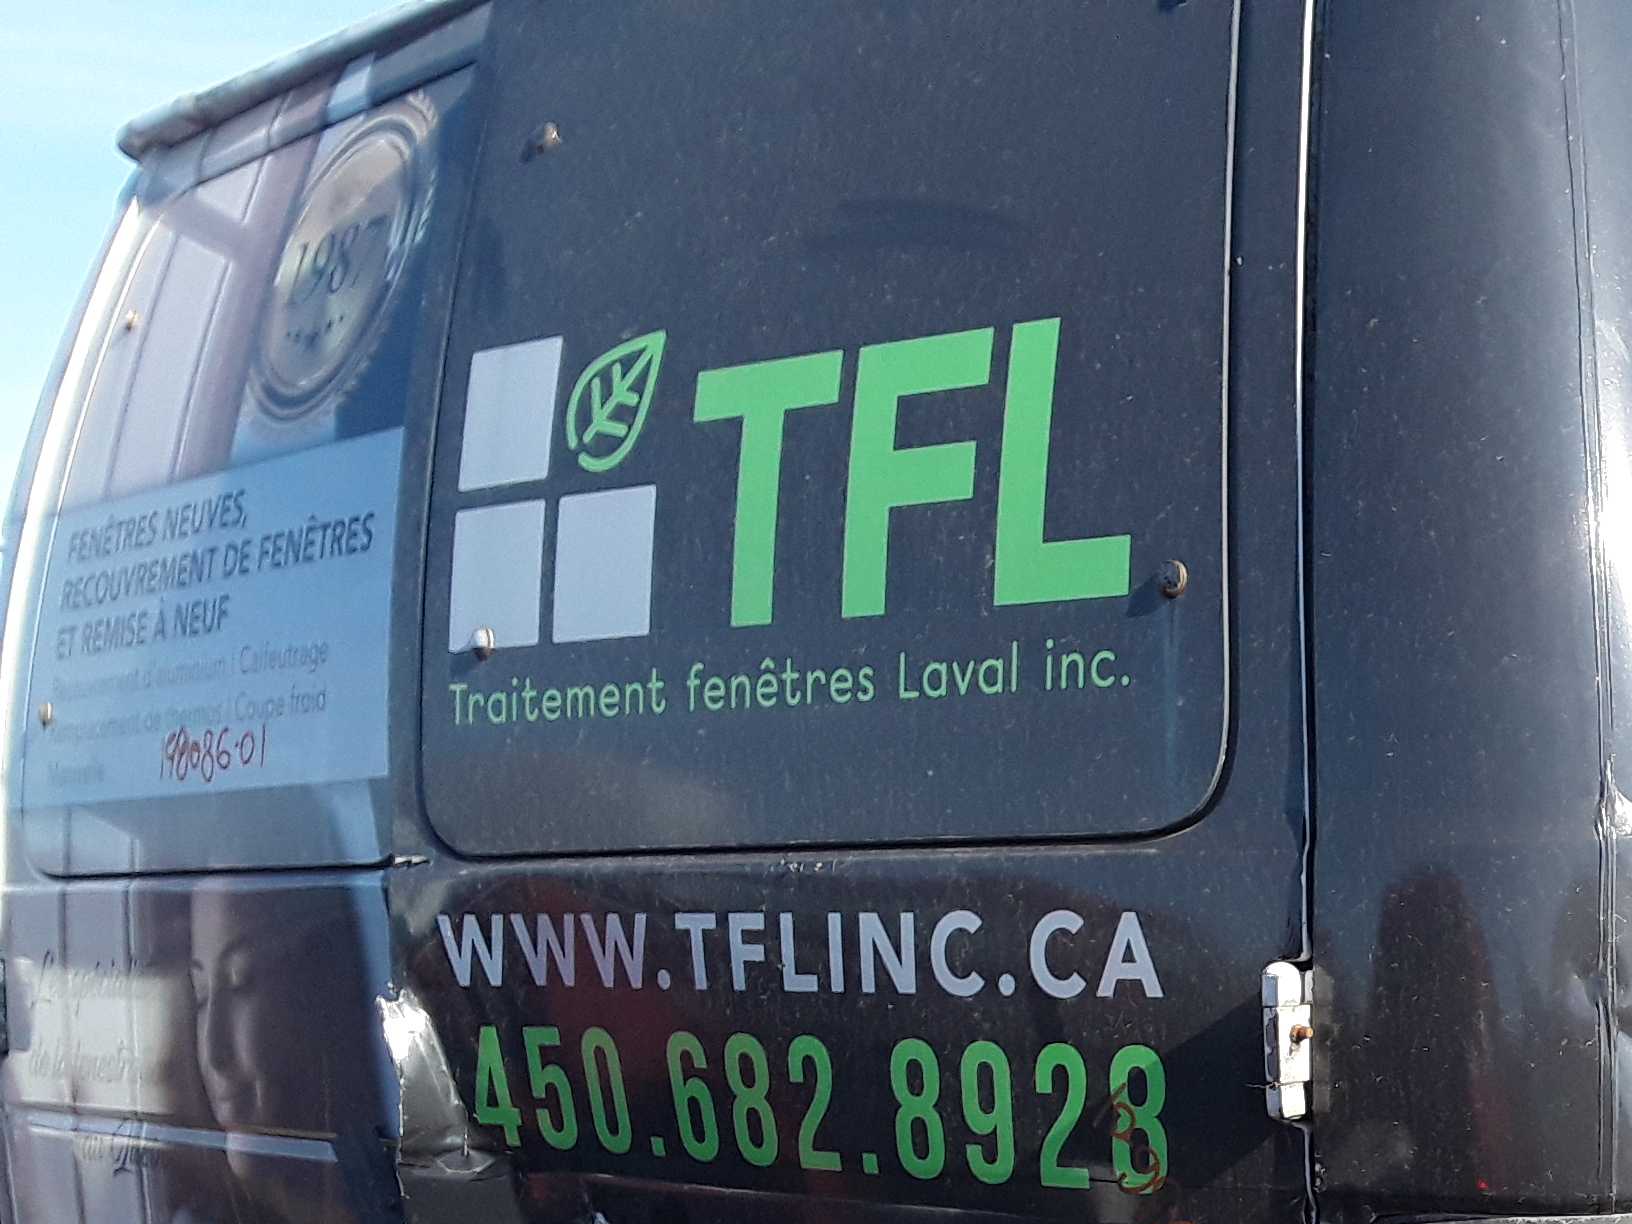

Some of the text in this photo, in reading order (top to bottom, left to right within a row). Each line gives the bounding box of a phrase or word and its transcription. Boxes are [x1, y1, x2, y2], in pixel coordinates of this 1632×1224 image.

[693, 317, 1131, 627] TFL
[60, 511, 376, 611] RECOUVREMENT DE FENÊTRES
[67, 489, 248, 563] FENÊTRES NEUVES,
[56, 594, 230, 660] ET REMISE À NEUF
[448, 639, 1132, 727] Traitement fenêtres Laval inc.
[437, 909, 1165, 999] WWW.TFLINC.CA
[474, 1024, 1168, 1195] 450.682.8928
